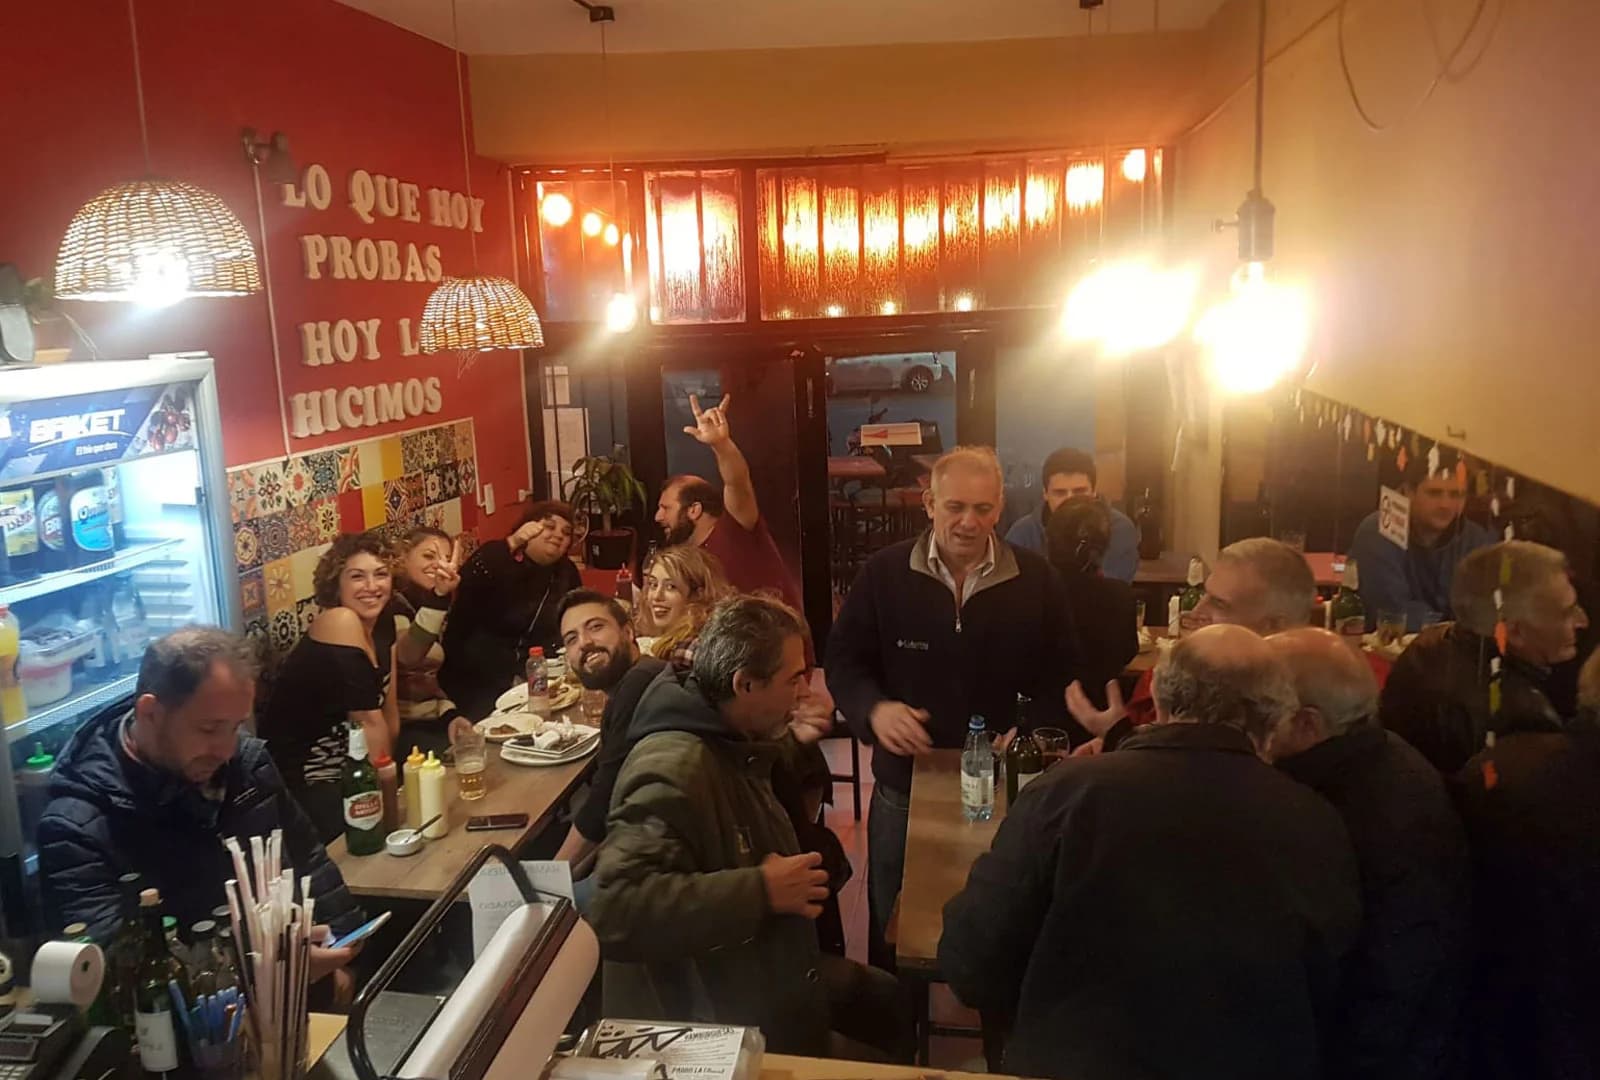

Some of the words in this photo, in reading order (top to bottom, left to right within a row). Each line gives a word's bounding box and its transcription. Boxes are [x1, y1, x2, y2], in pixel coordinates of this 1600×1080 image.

[283, 164, 332, 210] LO
[350, 170, 421, 224] QUE
[427, 187, 485, 233] HOY
[302, 234, 442, 282] PROBAS
[302, 318, 381, 366] HOY
[399, 318, 428, 357] L
[290, 377, 442, 438] HICIMOS
